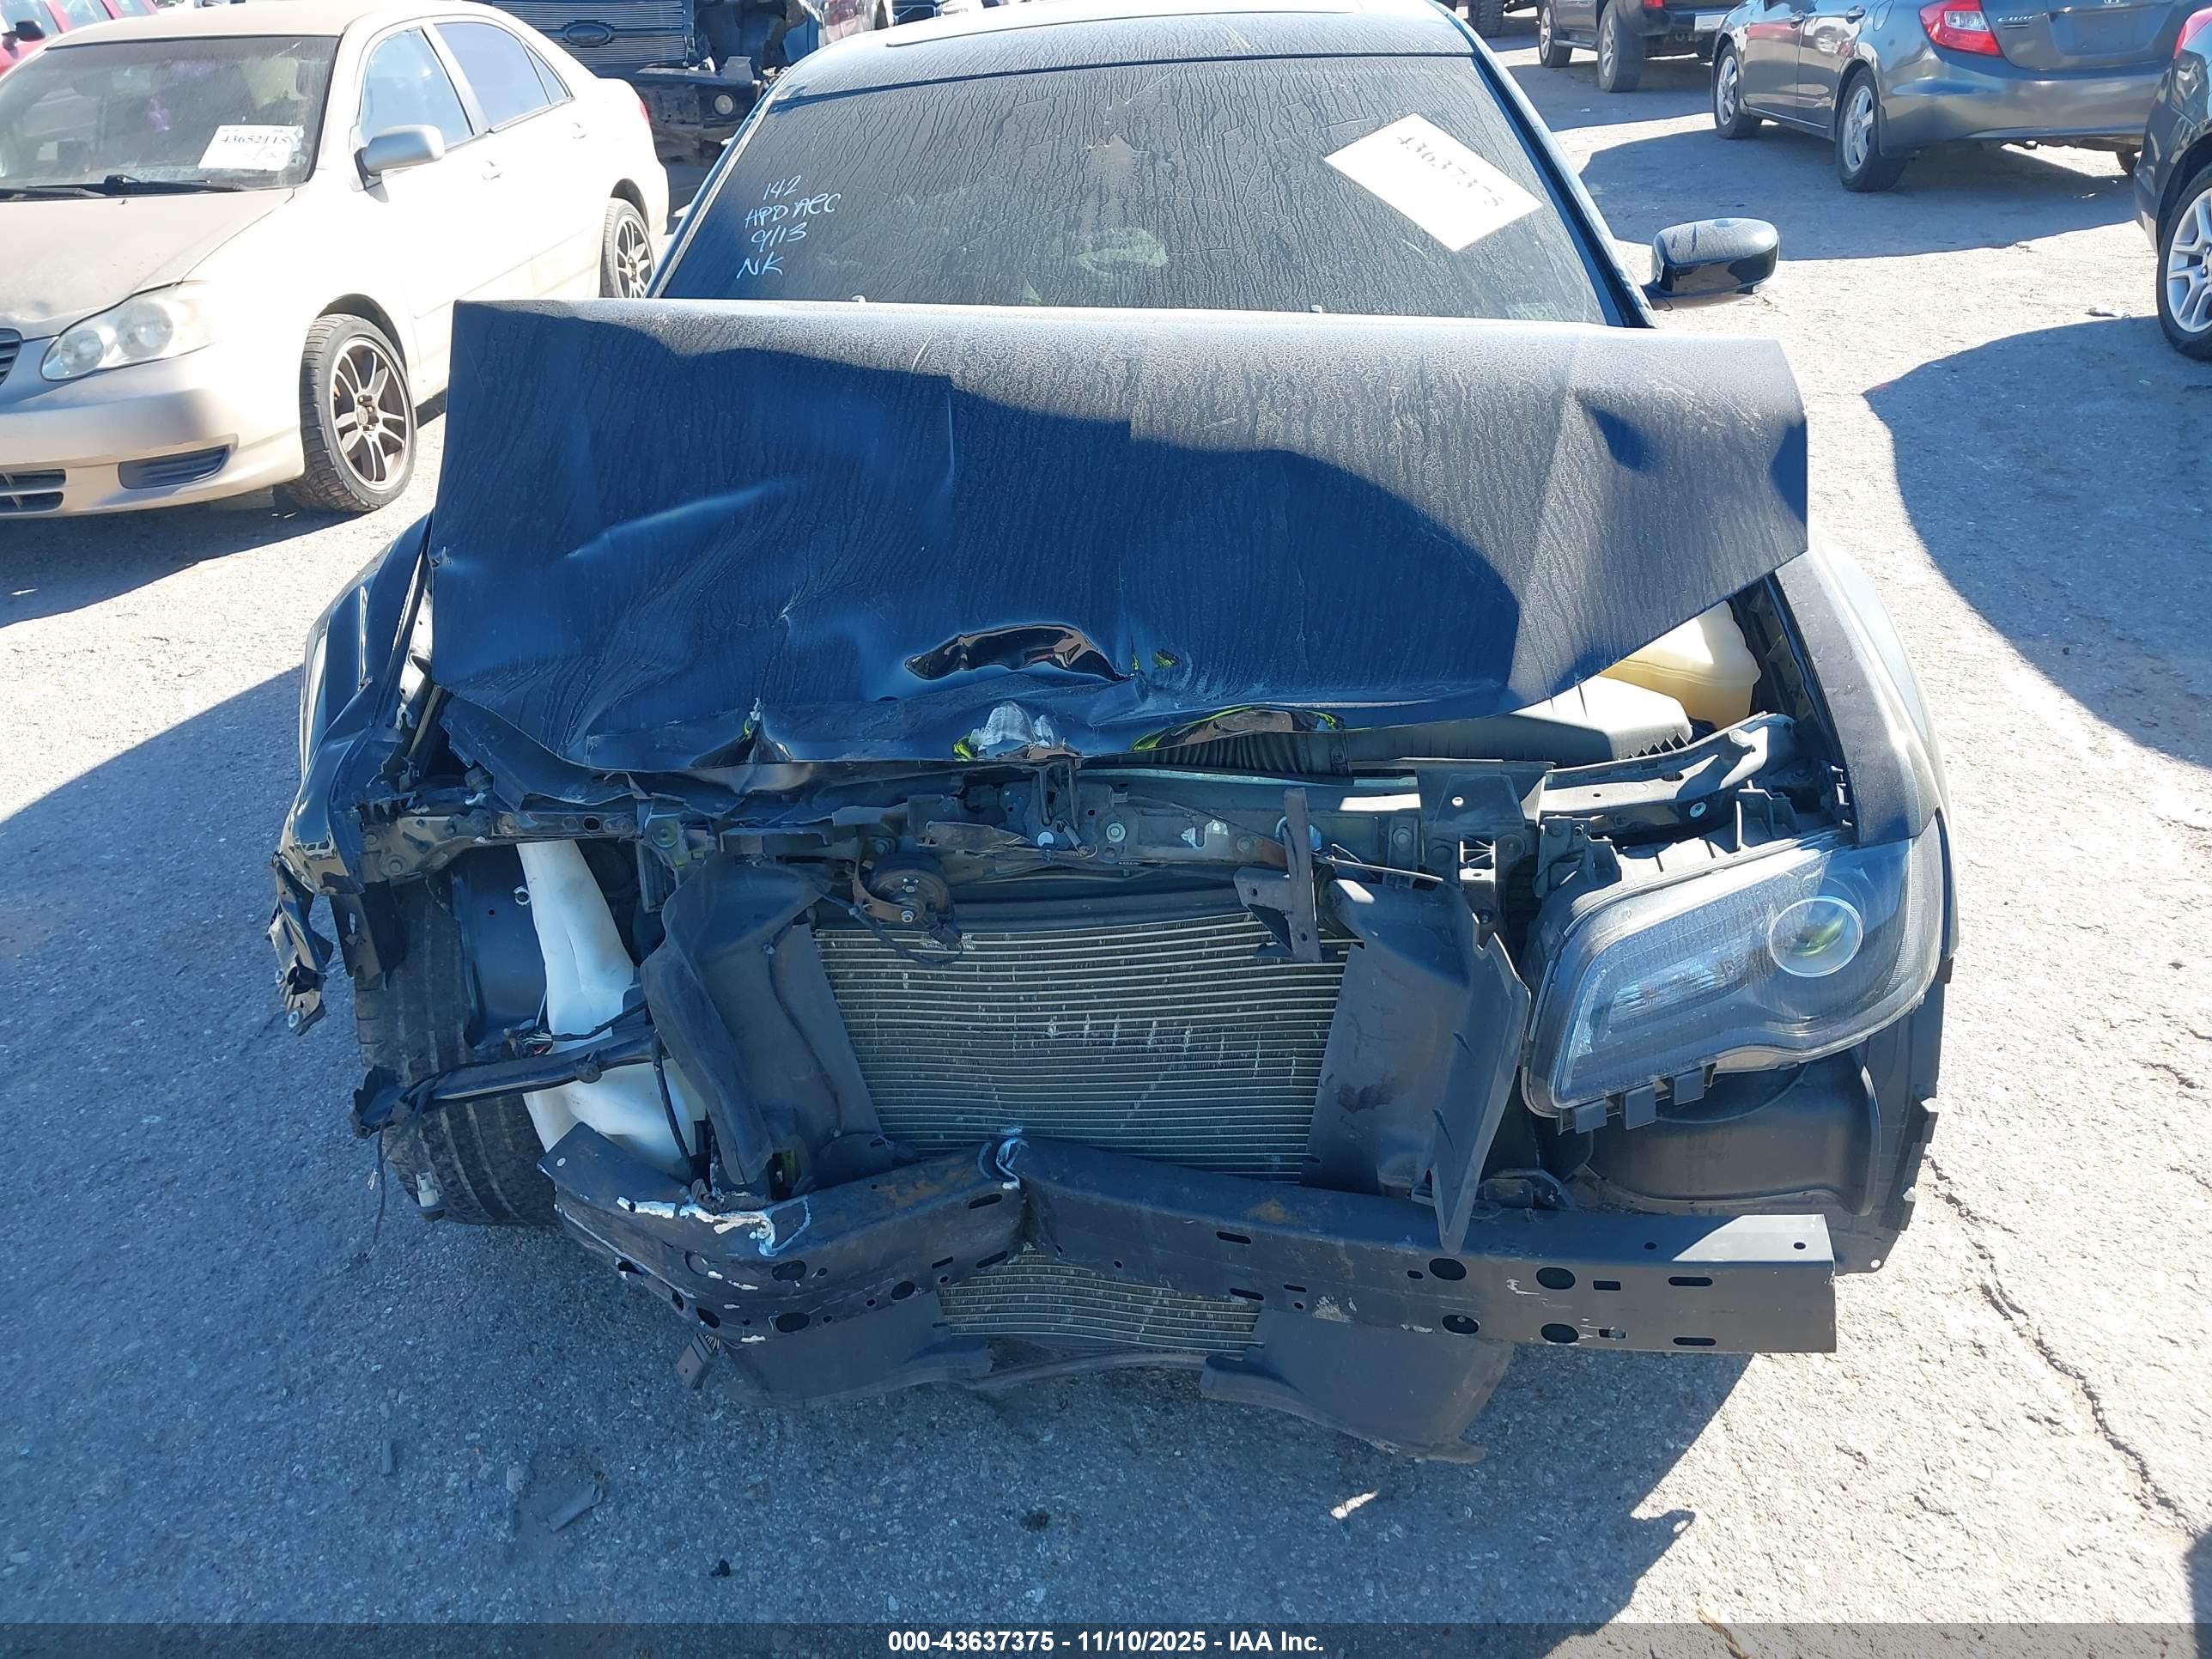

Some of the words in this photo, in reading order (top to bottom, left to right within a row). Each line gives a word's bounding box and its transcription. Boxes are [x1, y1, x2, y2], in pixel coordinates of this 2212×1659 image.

[763, 174, 802, 200] 142
[750, 222, 808, 252] 9/13
[736, 251, 784, 279] NK
